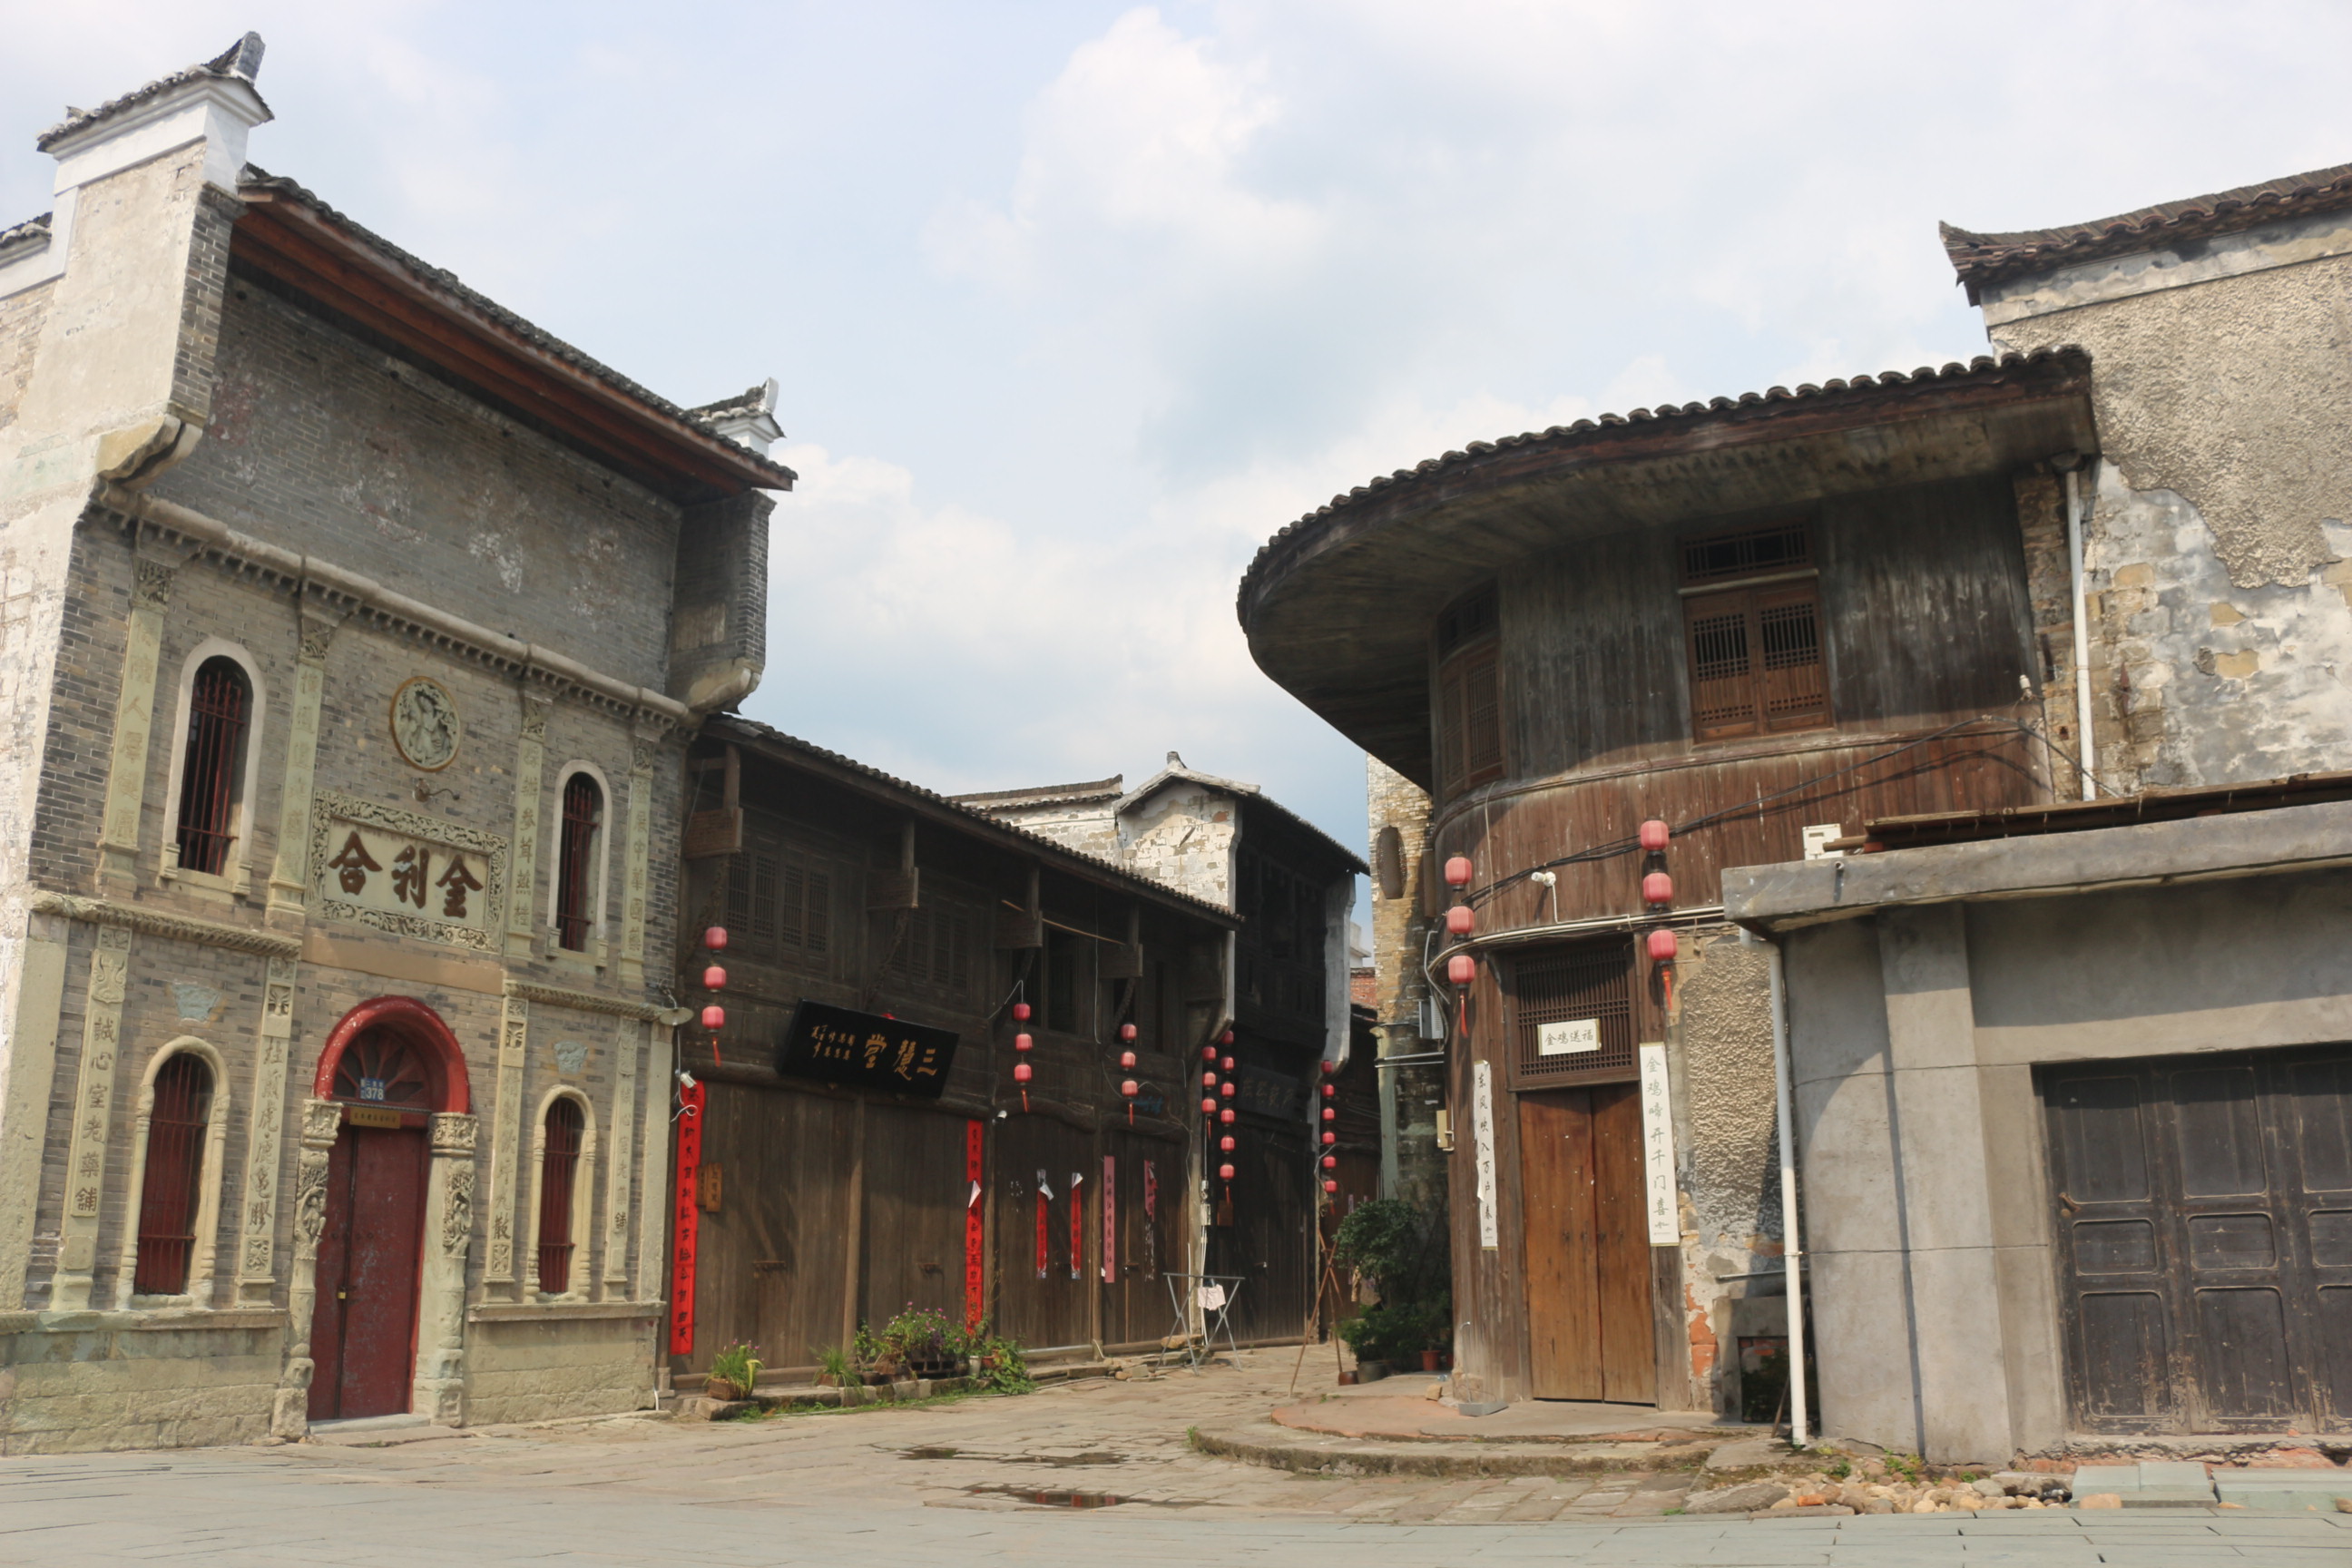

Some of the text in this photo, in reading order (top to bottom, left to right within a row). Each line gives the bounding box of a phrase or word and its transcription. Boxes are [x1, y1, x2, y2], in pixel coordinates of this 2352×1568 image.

[328, 829, 484, 919] 金利合
[1544, 1028, 1594, 1046] 金鸡送福
[365, 1087, 384, 1101] 378
[1645, 1055, 1671, 1217] 金鸡啼开千门喜
